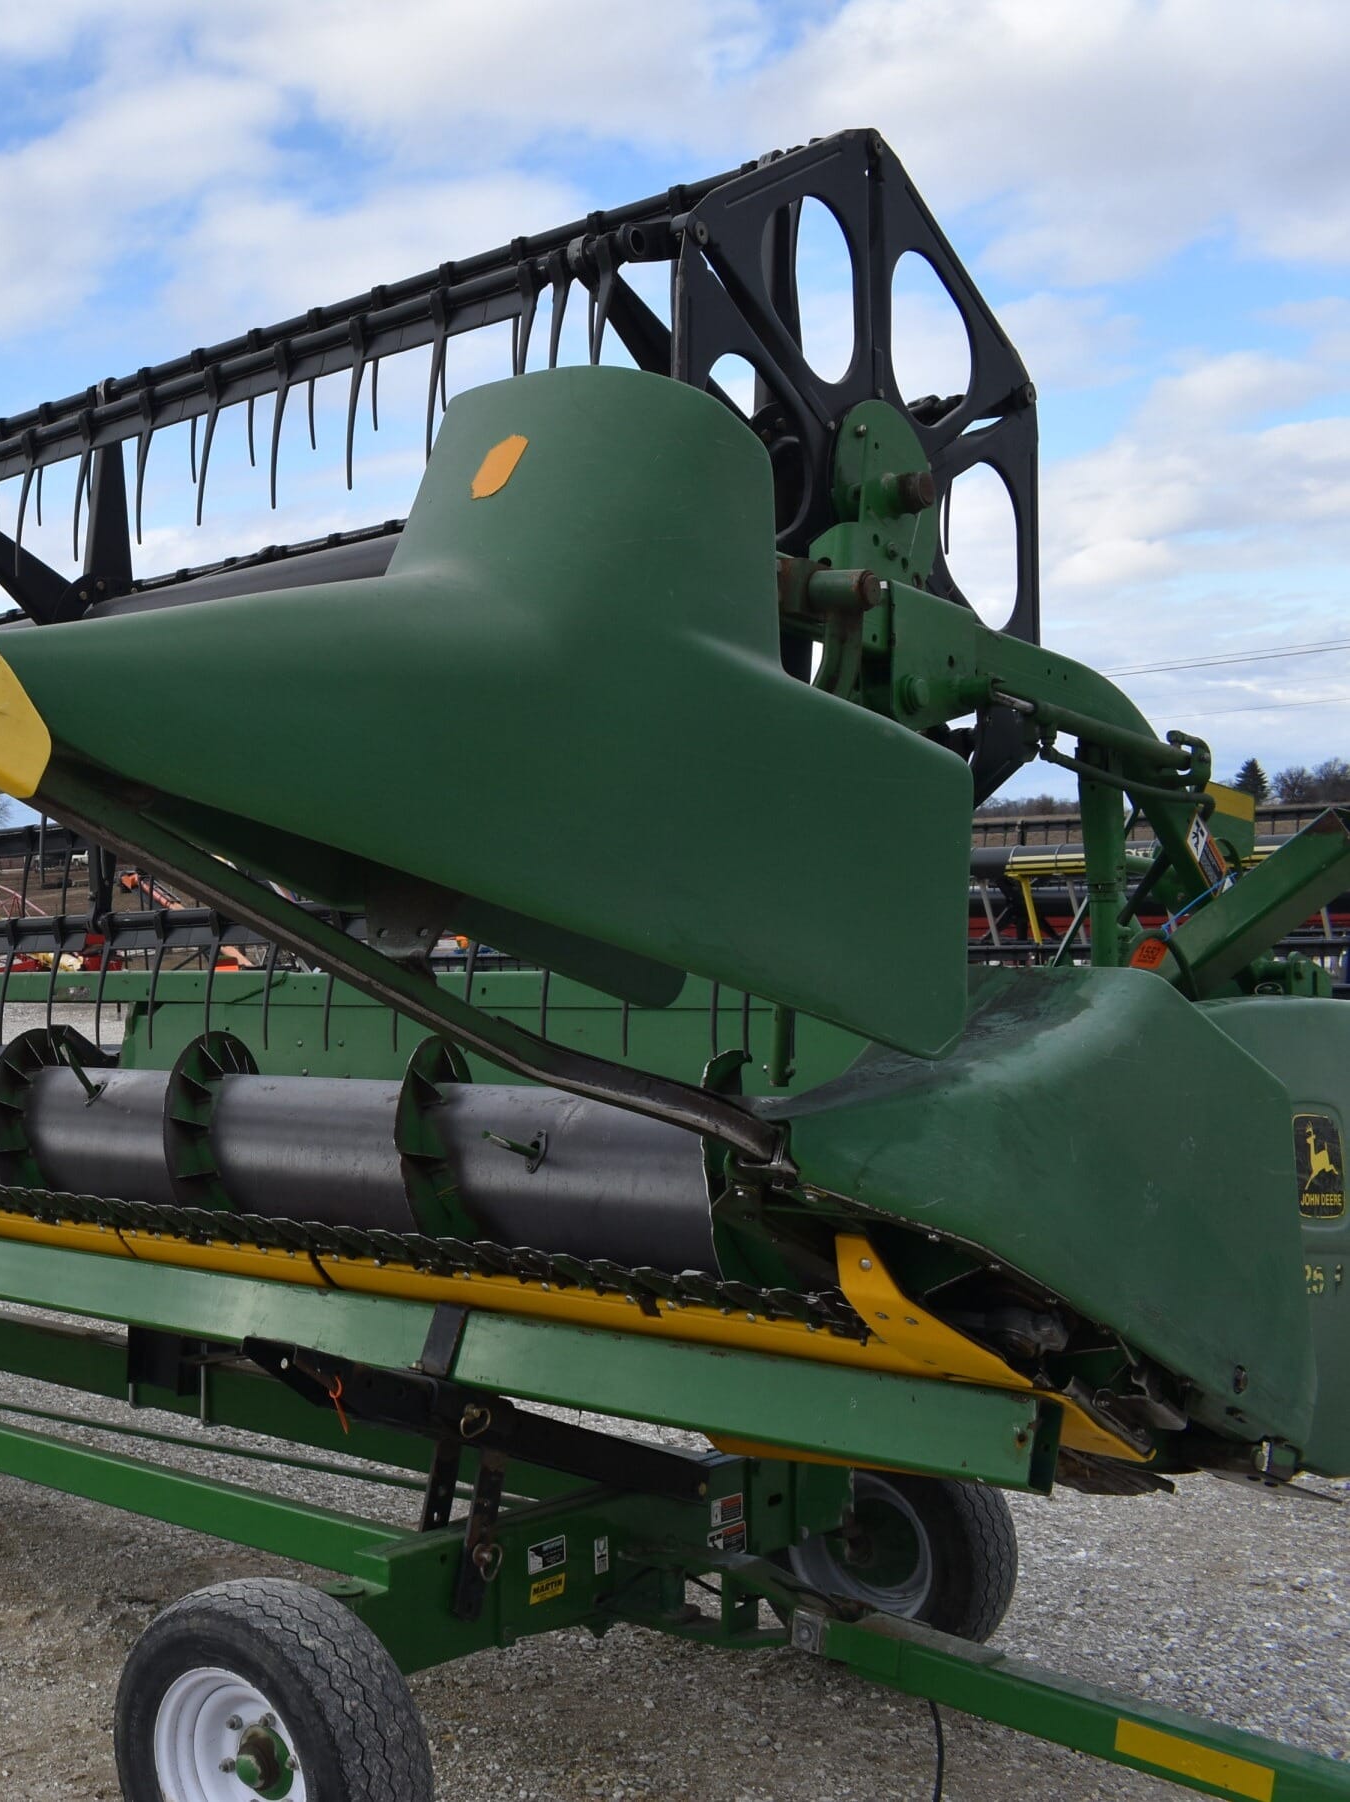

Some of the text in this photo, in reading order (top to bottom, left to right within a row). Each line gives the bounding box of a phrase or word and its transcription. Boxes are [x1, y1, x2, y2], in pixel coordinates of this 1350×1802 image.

[1301, 1193, 1342, 1206] JOHN DEERE
[533, 1579, 562, 1594] MARTIN
